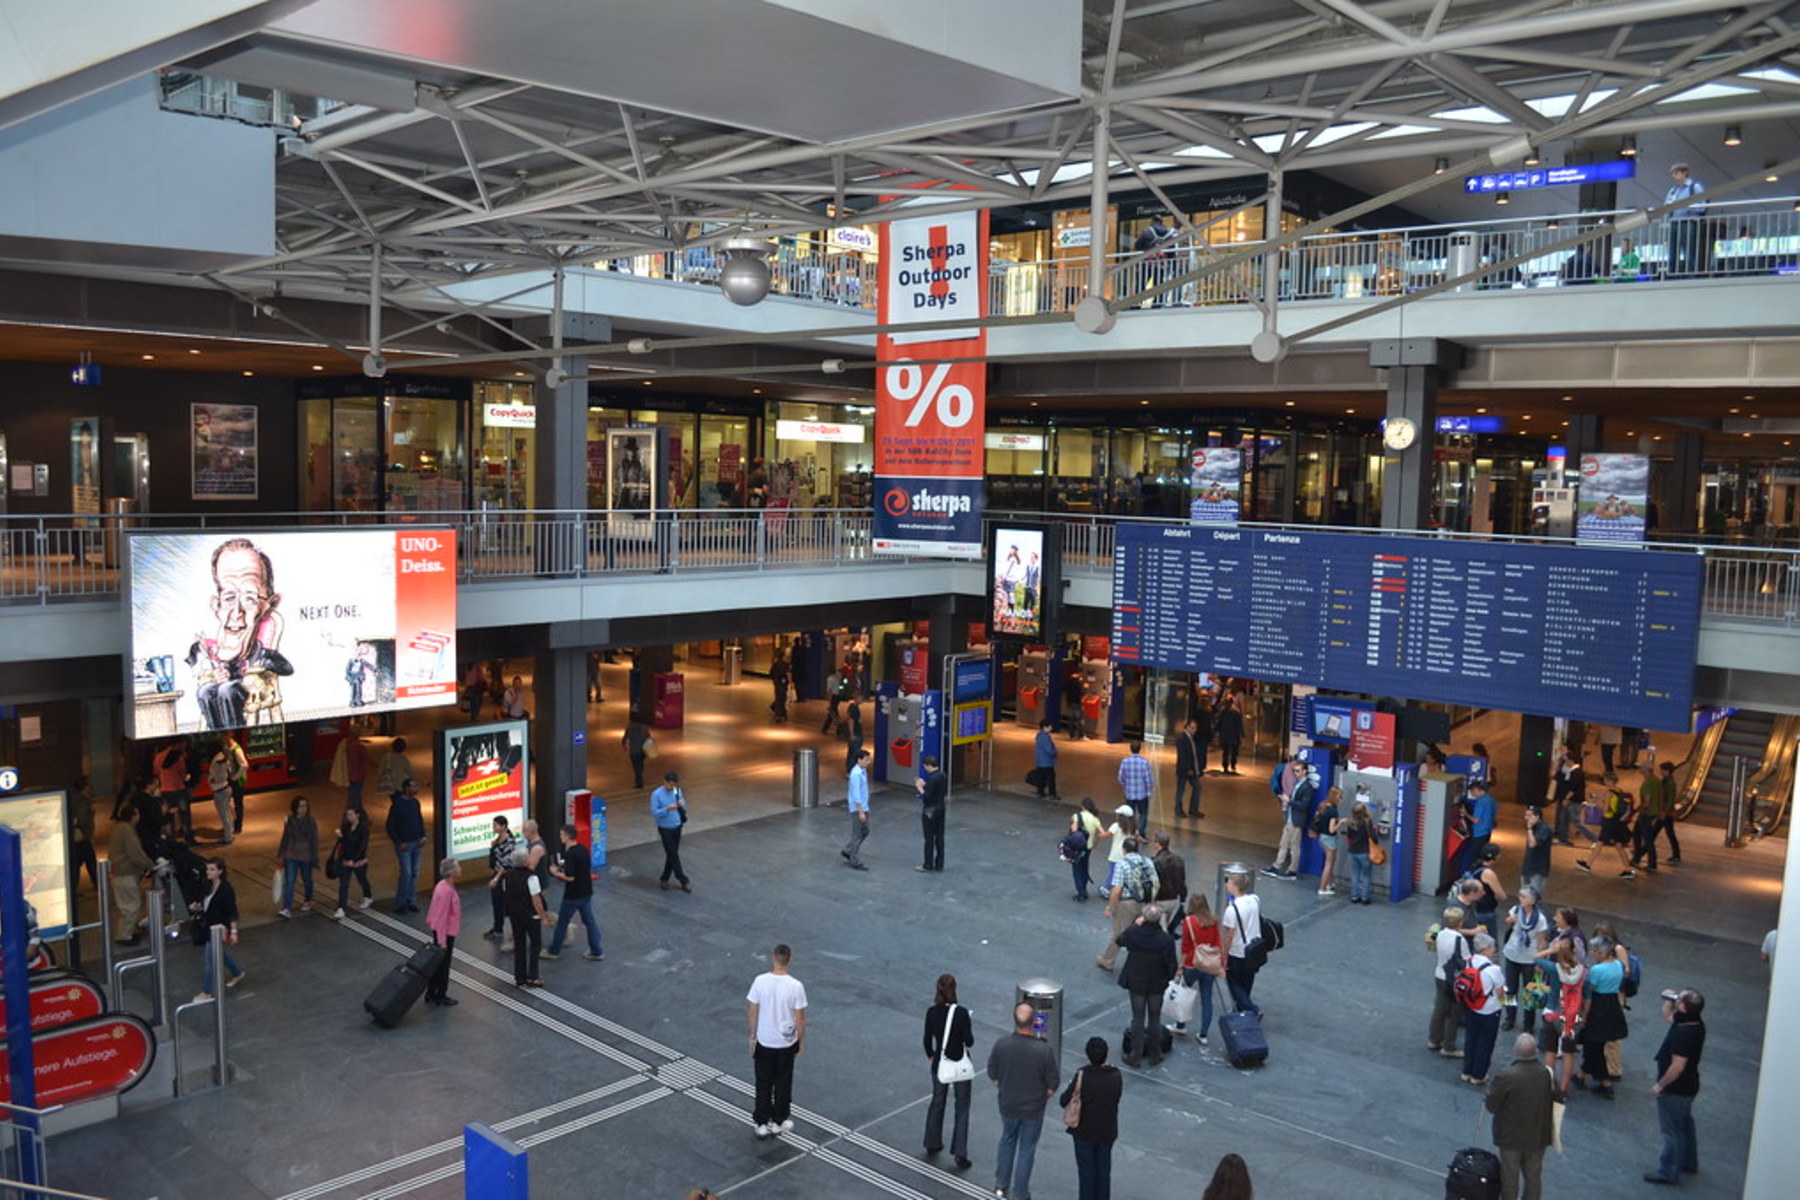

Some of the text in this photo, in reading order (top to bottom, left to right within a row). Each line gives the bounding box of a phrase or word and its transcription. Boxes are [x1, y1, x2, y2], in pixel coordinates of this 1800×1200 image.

[837, 229, 871, 246] claire's
[902, 243, 966, 262] Sherpa
[898, 266, 972, 286] Outdoor
[913, 292, 958, 310] Days
[885, 357, 974, 428] %
[490, 408, 534, 418] CopyQuick
[800, 424, 841, 434] CopyQuick
[912, 488, 971, 518] sherpa
[1163, 528, 1301, 544] Abfahrt Départ Partenza
[401, 537, 443, 553] UNO-
[401, 558, 446, 573] Deiss.
[300, 604, 362, 621] NEXT ONE.
[453, 822, 491, 836] Schweizer
[453, 833, 482, 845] wählen
[32, 1009, 74, 1026] ufstiege.
[63, 1048, 119, 1069] Aufstiege.
